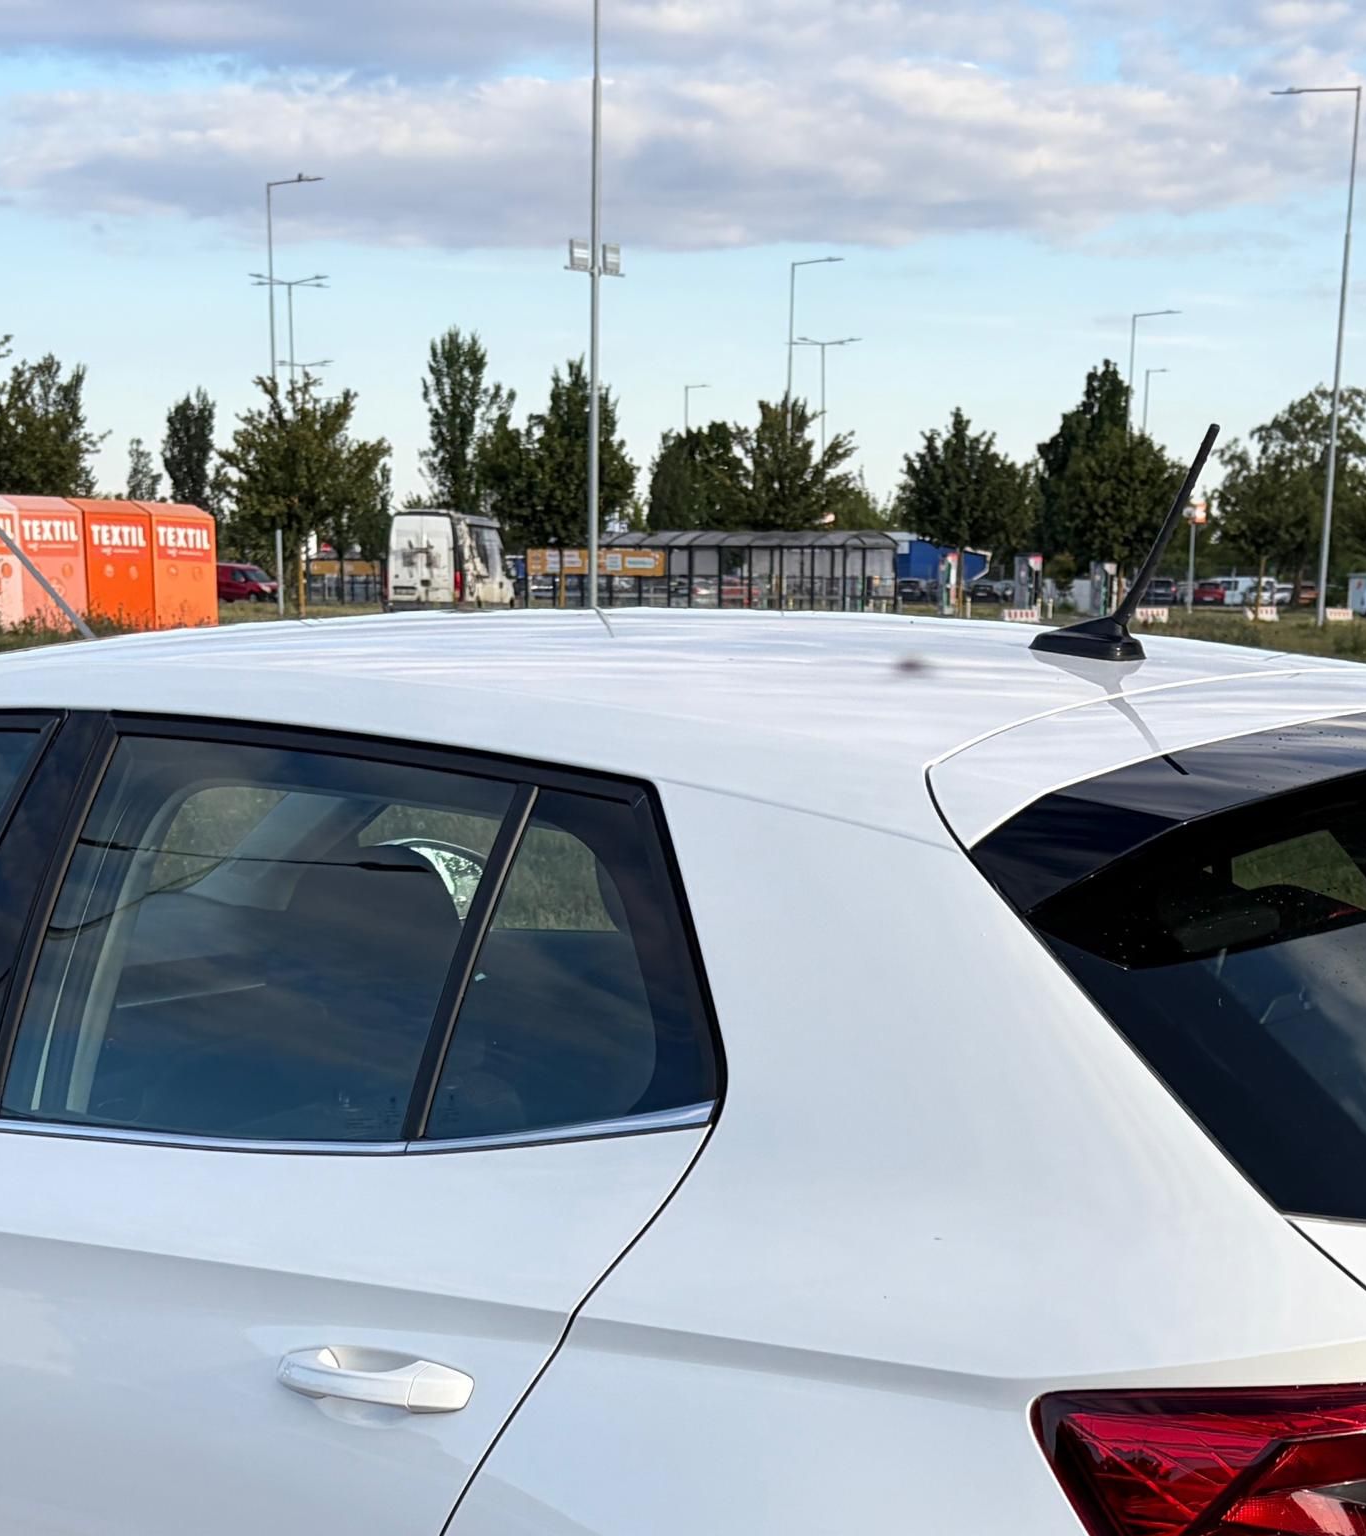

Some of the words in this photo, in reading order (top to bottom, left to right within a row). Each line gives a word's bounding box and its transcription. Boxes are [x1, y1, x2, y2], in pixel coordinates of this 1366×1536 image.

[22, 519, 79, 542] TEXTIL
[90, 524, 147, 548] TEXTIL
[157, 526, 211, 550] TEXTIL
